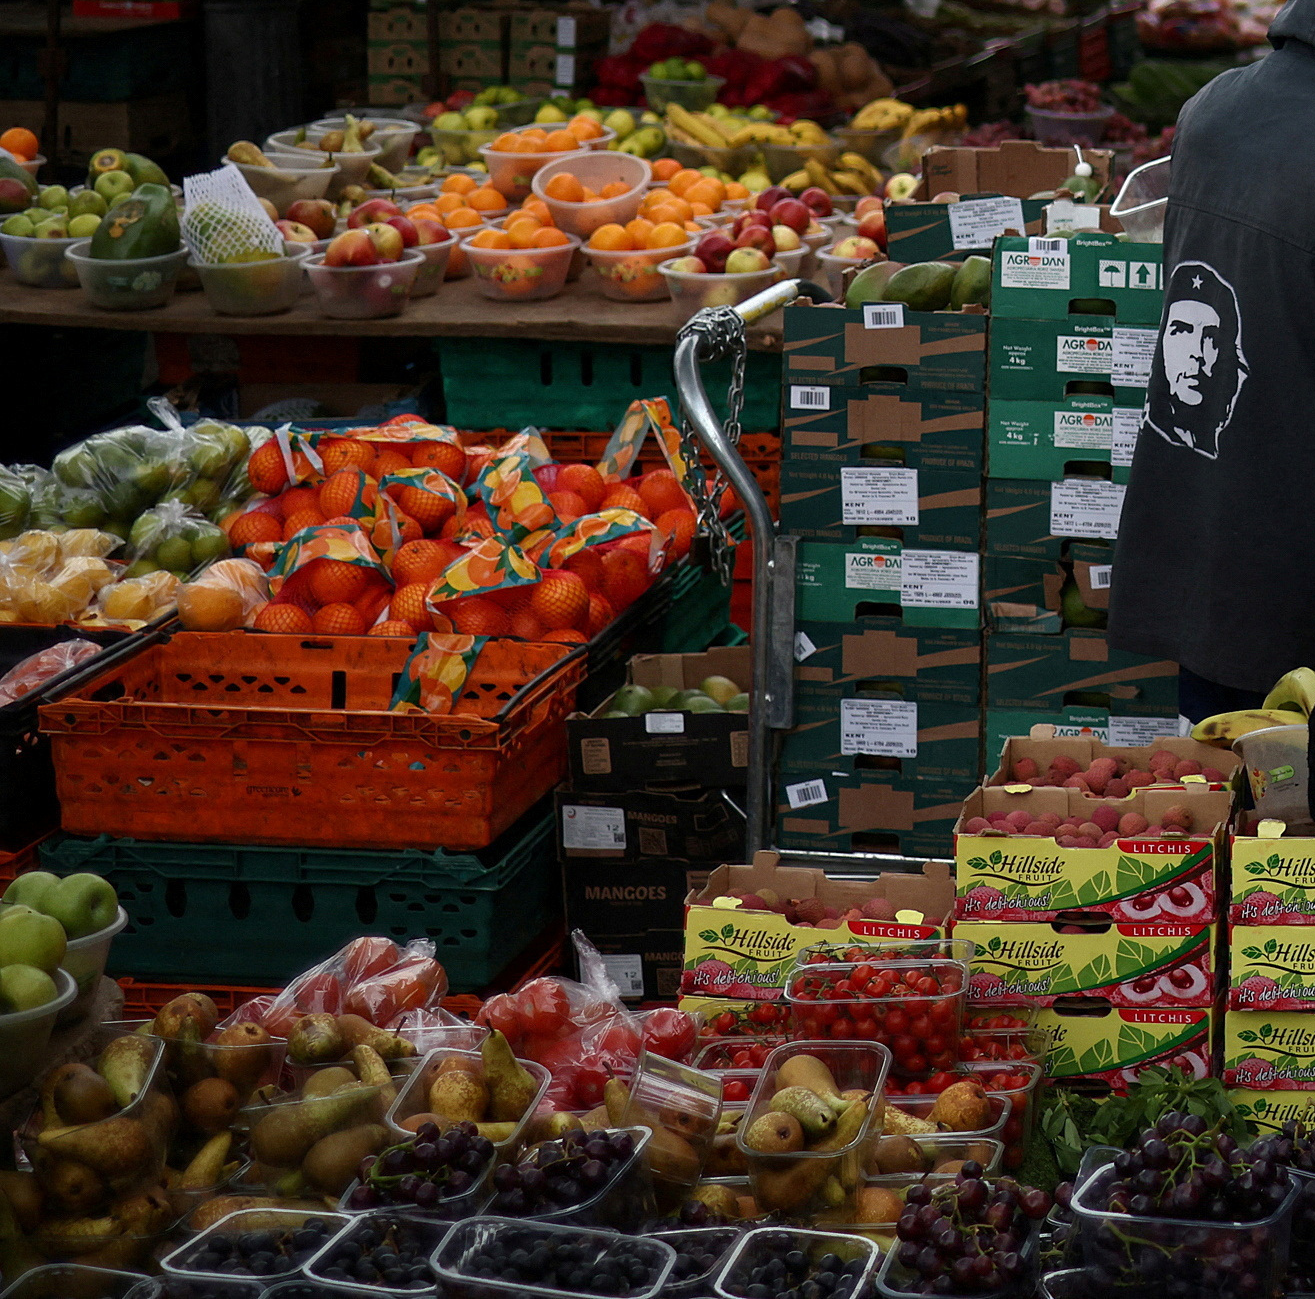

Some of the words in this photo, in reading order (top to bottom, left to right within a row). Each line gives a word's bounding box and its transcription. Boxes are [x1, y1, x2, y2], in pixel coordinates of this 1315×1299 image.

[627, 810, 677, 824] MANGOES
[1133, 844, 1191, 854] LITCHIS
[996, 855, 1066, 874] Hillside
[585, 886, 667, 900] MANGOES
[964, 897, 981, 912] it's
[1241, 902, 1257, 918] it's
[863, 925, 921, 939] LITCHIS
[1133, 926, 1191, 936] LITCHIS
[726, 929, 796, 950] Hillside
[749, 949, 783, 958] FRUIT
[999, 940, 1065, 959] Hillside
[693, 970, 710, 986] it's
[968, 984, 981, 998] t's
[1238, 987, 1255, 1003] it's
[1134, 1013, 1192, 1023] LITCHIS
[1235, 1069, 1251, 1083] it's
